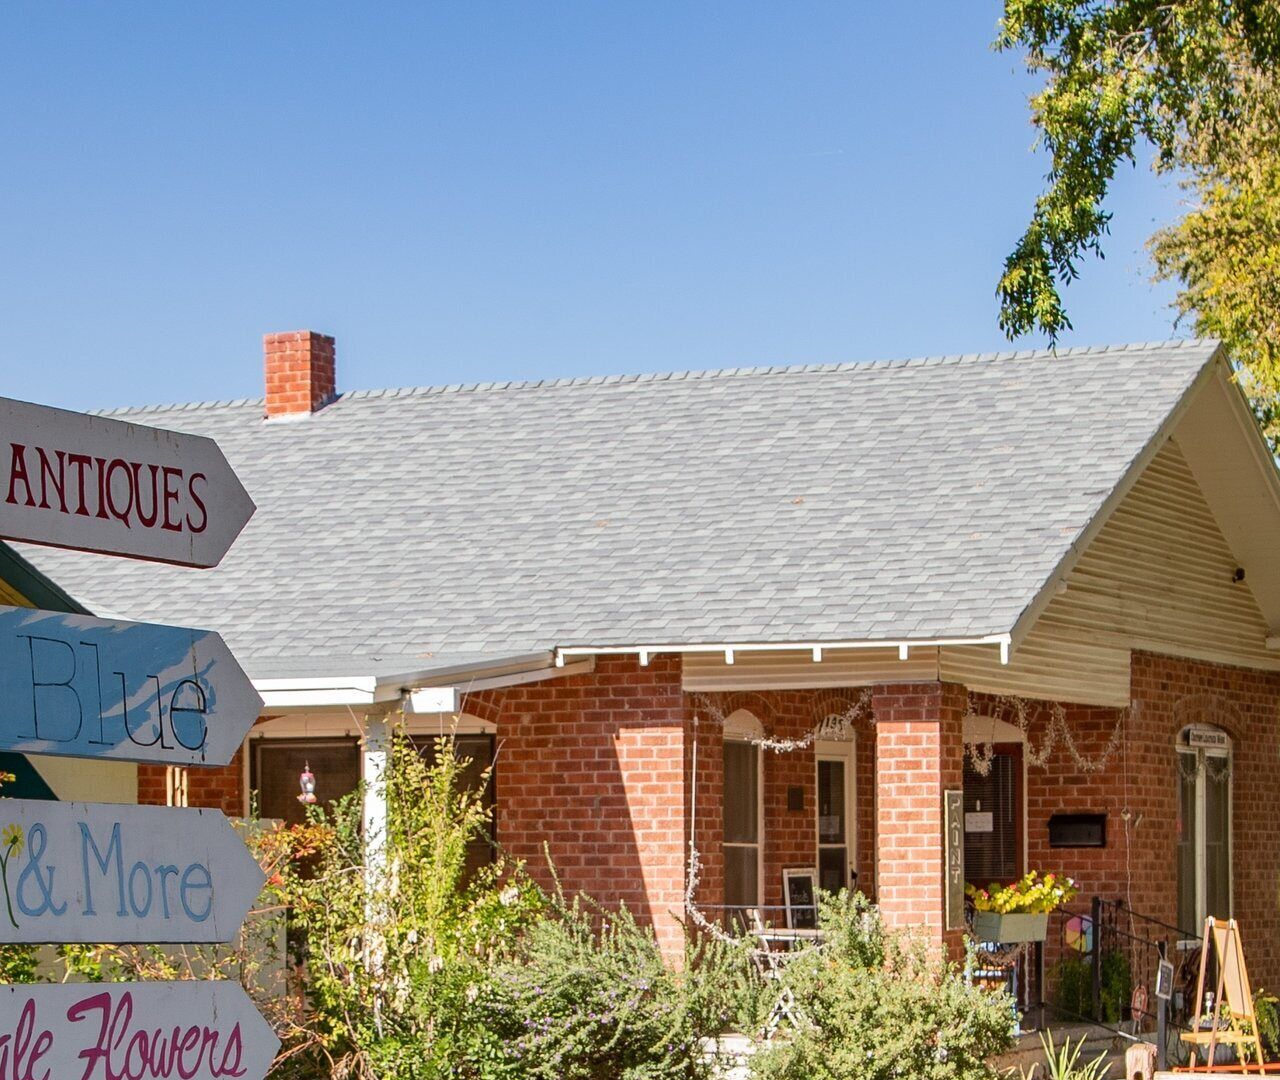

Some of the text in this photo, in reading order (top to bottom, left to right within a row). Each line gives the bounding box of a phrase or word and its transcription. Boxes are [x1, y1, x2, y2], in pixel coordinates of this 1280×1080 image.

[6, 443, 208, 533] ANTIQUES
[17, 635, 209, 752] Blue
[16, 822, 68, 918] &
[78, 822, 214, 922] More
[950, 798, 961, 884] PAINT
